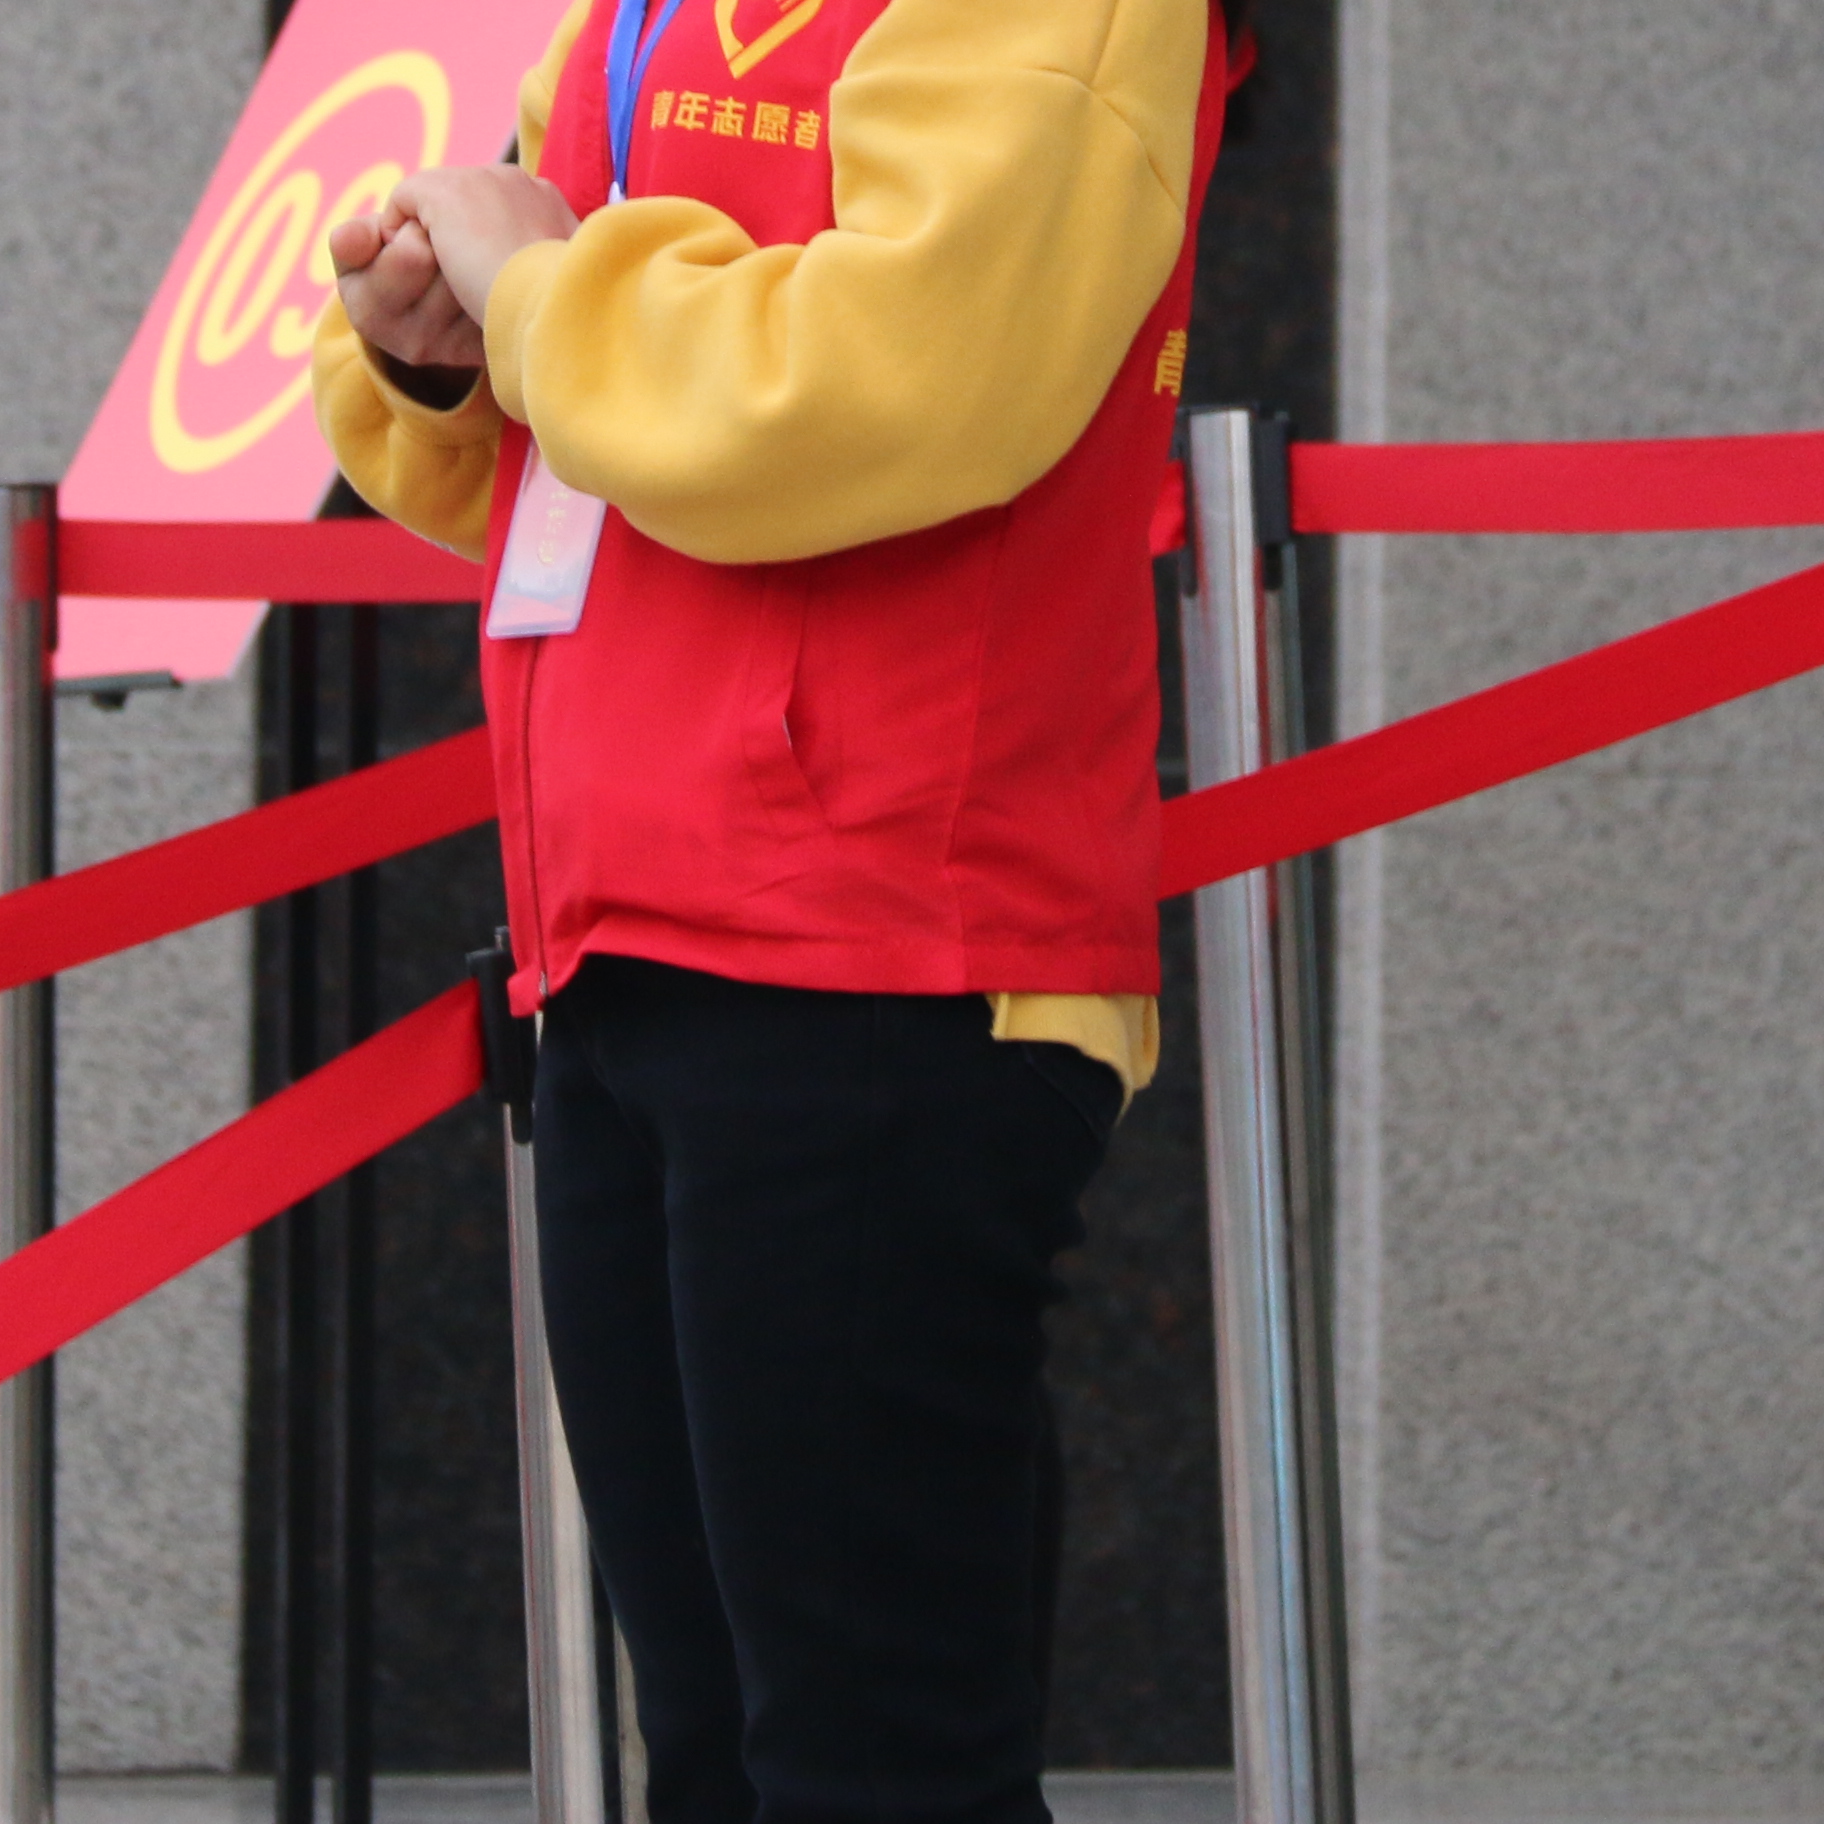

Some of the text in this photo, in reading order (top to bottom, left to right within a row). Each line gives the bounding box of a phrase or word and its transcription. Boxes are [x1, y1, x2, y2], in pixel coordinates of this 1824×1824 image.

[650, 90, 822, 151] 青年志愿者
